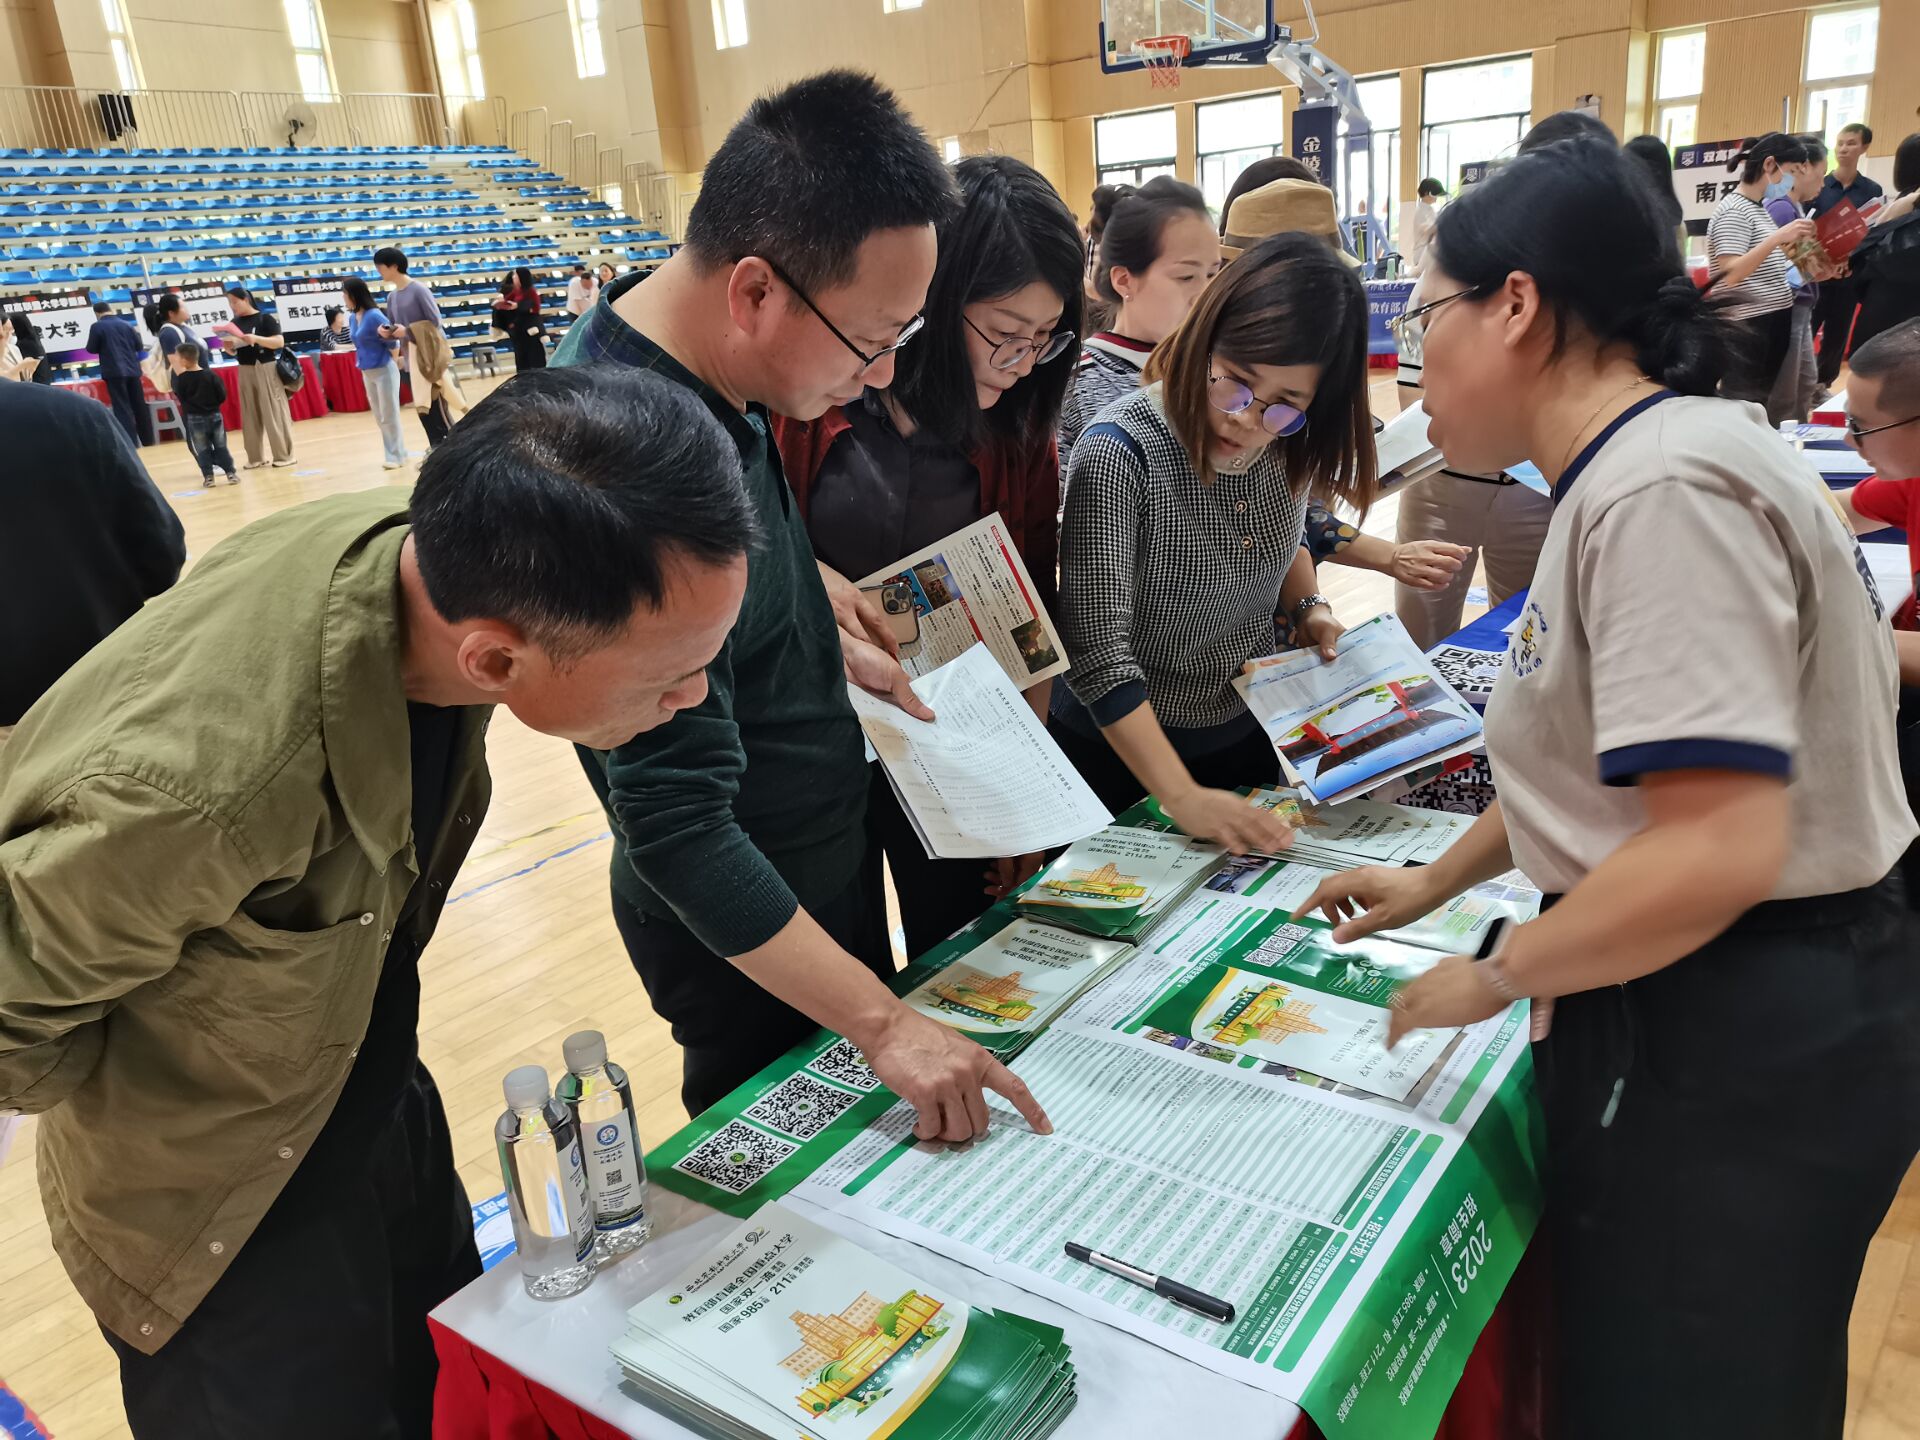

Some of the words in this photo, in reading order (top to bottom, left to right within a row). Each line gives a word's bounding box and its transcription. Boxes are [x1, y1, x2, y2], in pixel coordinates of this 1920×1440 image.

[1350, 1220, 1383, 1259] 招生计划
[1440, 1193, 1478, 1257] 招生简章
[1451, 1219, 1492, 1294] 2023
[682, 1233, 794, 1323] 教育部直属全国重点大学
